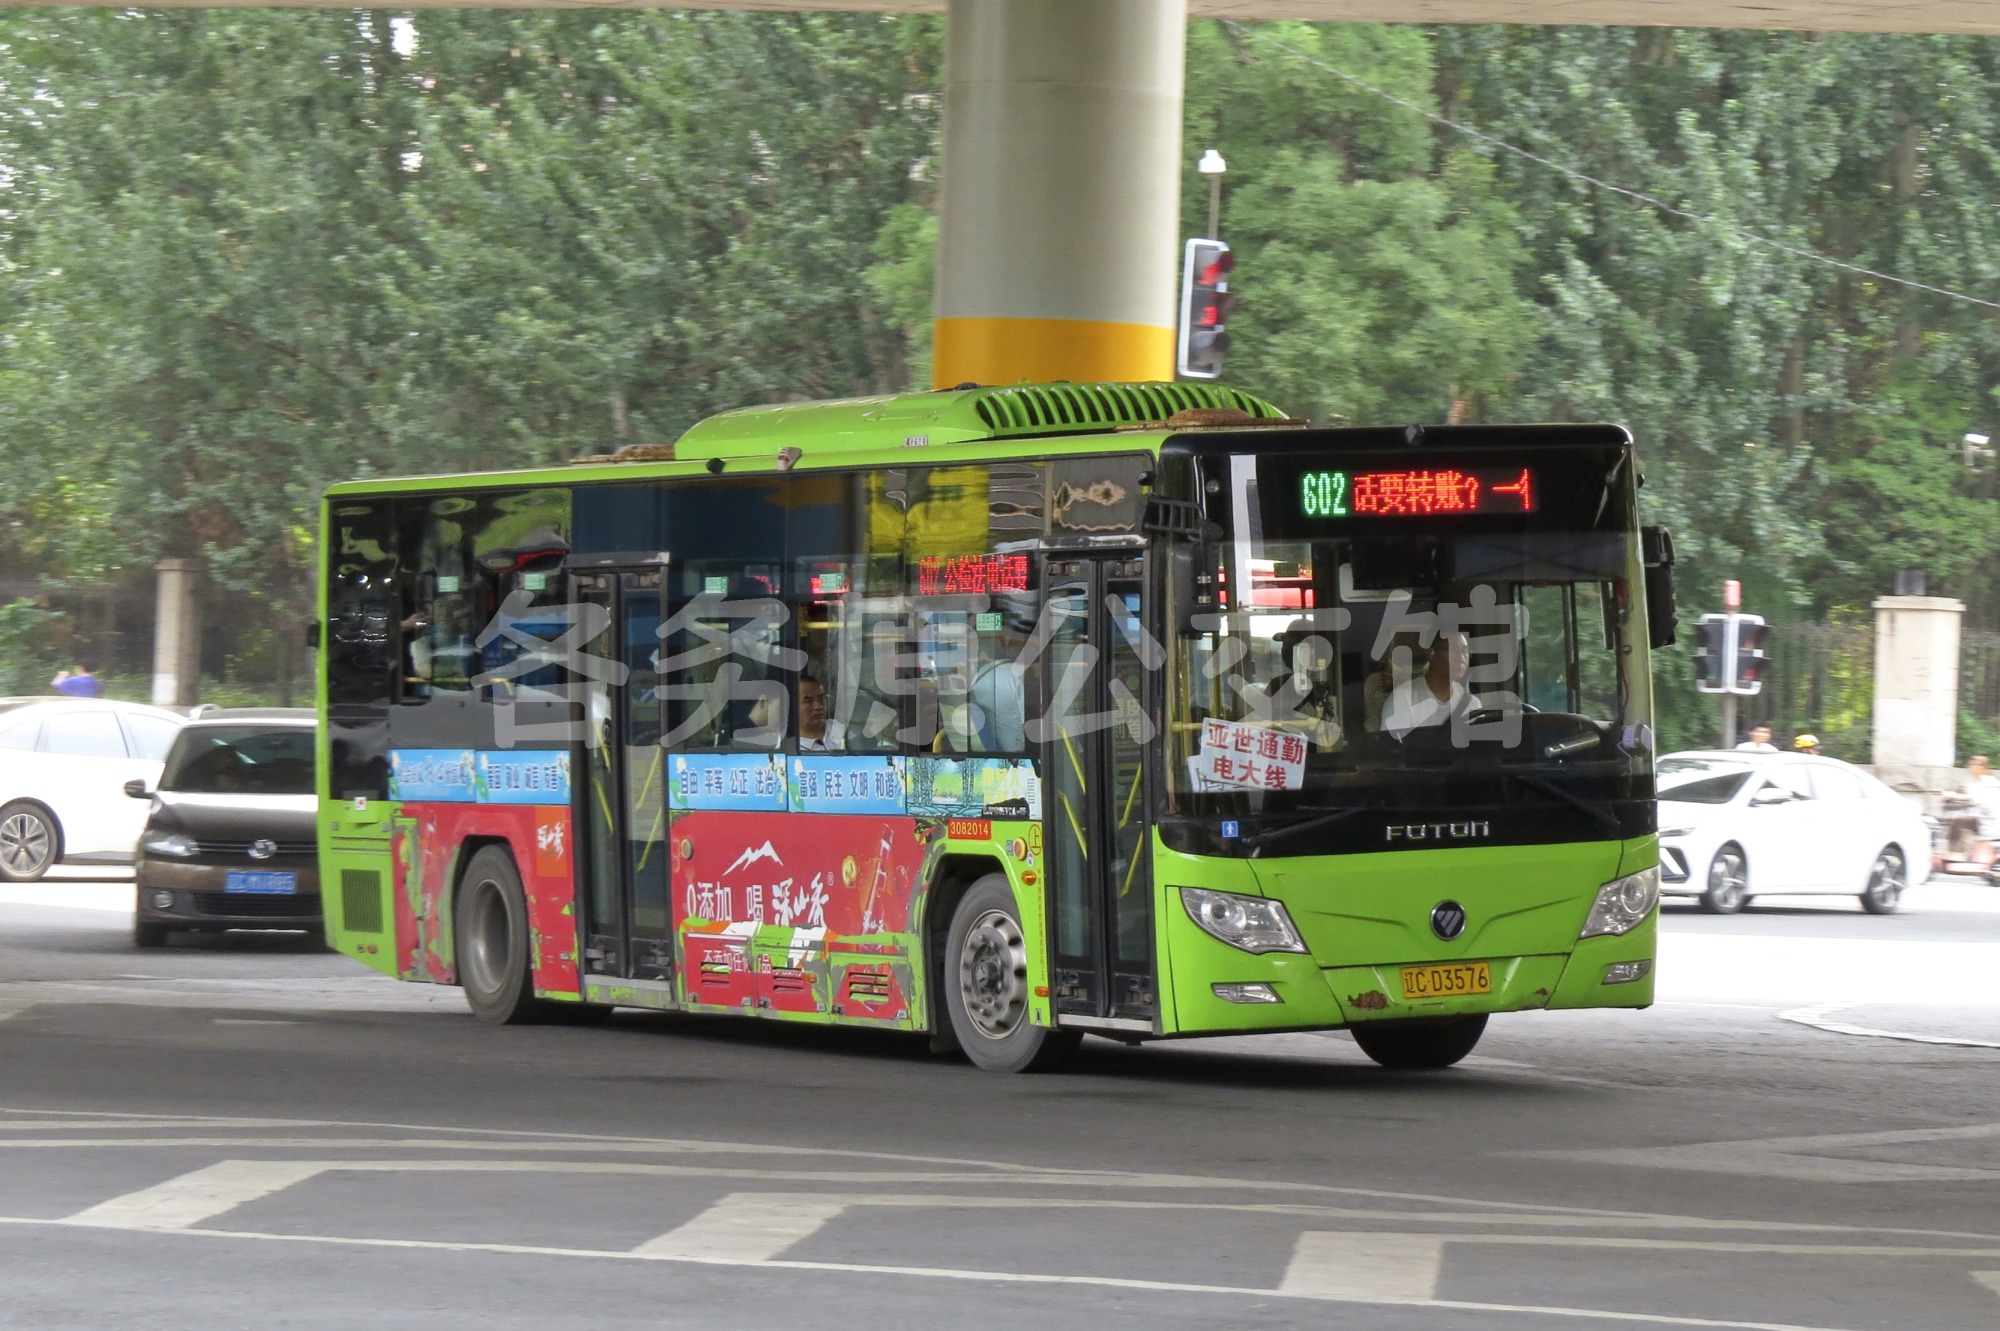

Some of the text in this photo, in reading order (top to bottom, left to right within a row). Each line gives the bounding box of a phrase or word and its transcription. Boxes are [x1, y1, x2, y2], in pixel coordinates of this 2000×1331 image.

[1303, 472, 1346, 514] 602
[1206, 723, 1304, 765] 亚世通勤
[680, 769, 775, 797] 自由 平等 公正 法治
[799, 770, 895, 799] 富强 民主 文明 和谐
[1213, 755, 1288, 791] 电大线
[950, 822, 989, 836] 3082014
[1386, 821, 1489, 841] FOTON
[747, 885, 764, 922] 喝
